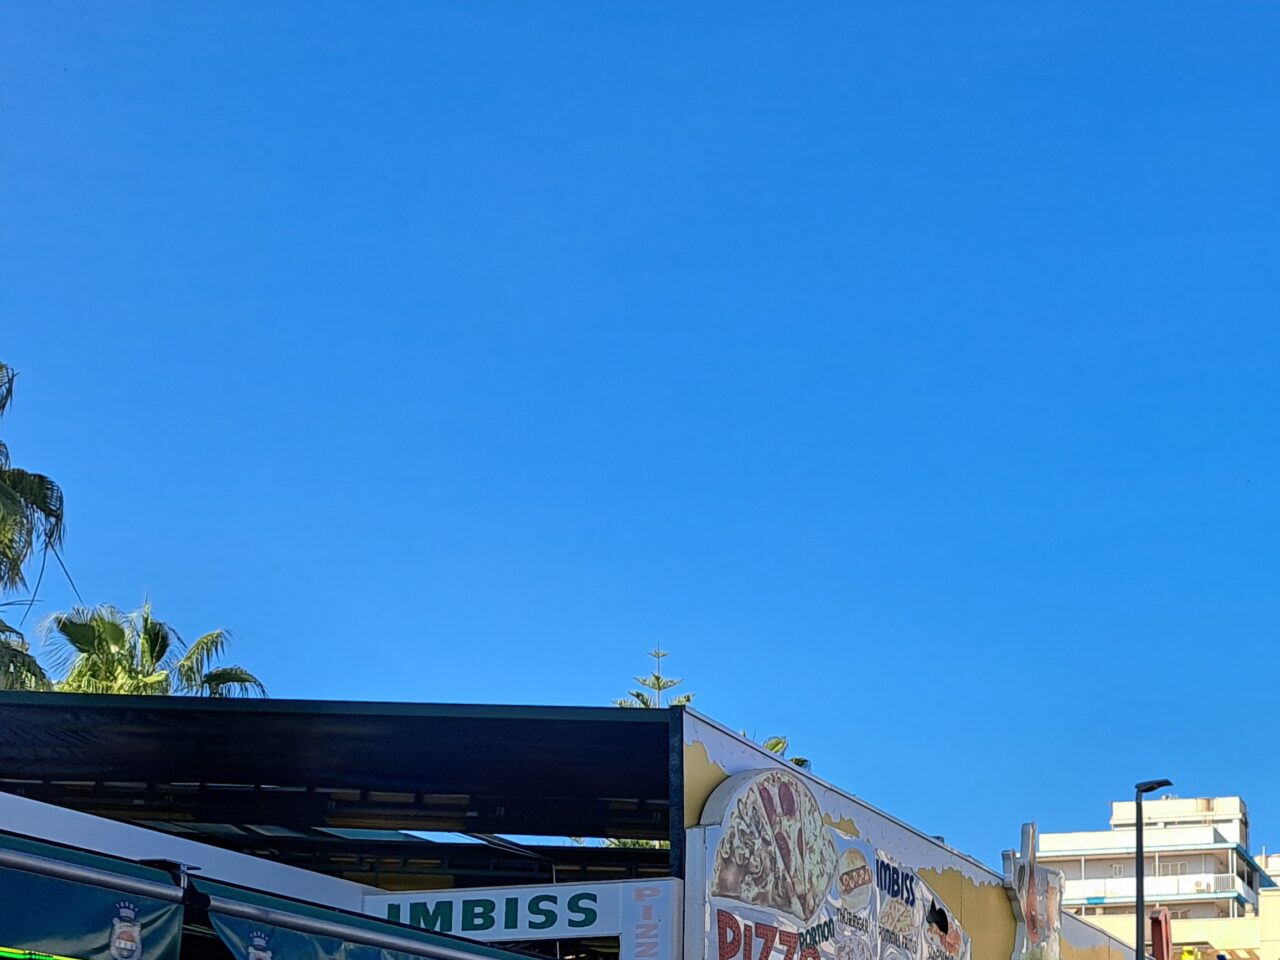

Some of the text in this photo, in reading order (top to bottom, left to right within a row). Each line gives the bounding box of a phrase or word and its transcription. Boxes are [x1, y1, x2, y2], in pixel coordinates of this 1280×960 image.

[876, 858, 915, 907] IMBISS
[387, 892, 598, 932] IMBISS
[798, 917, 835, 949] PORTION
